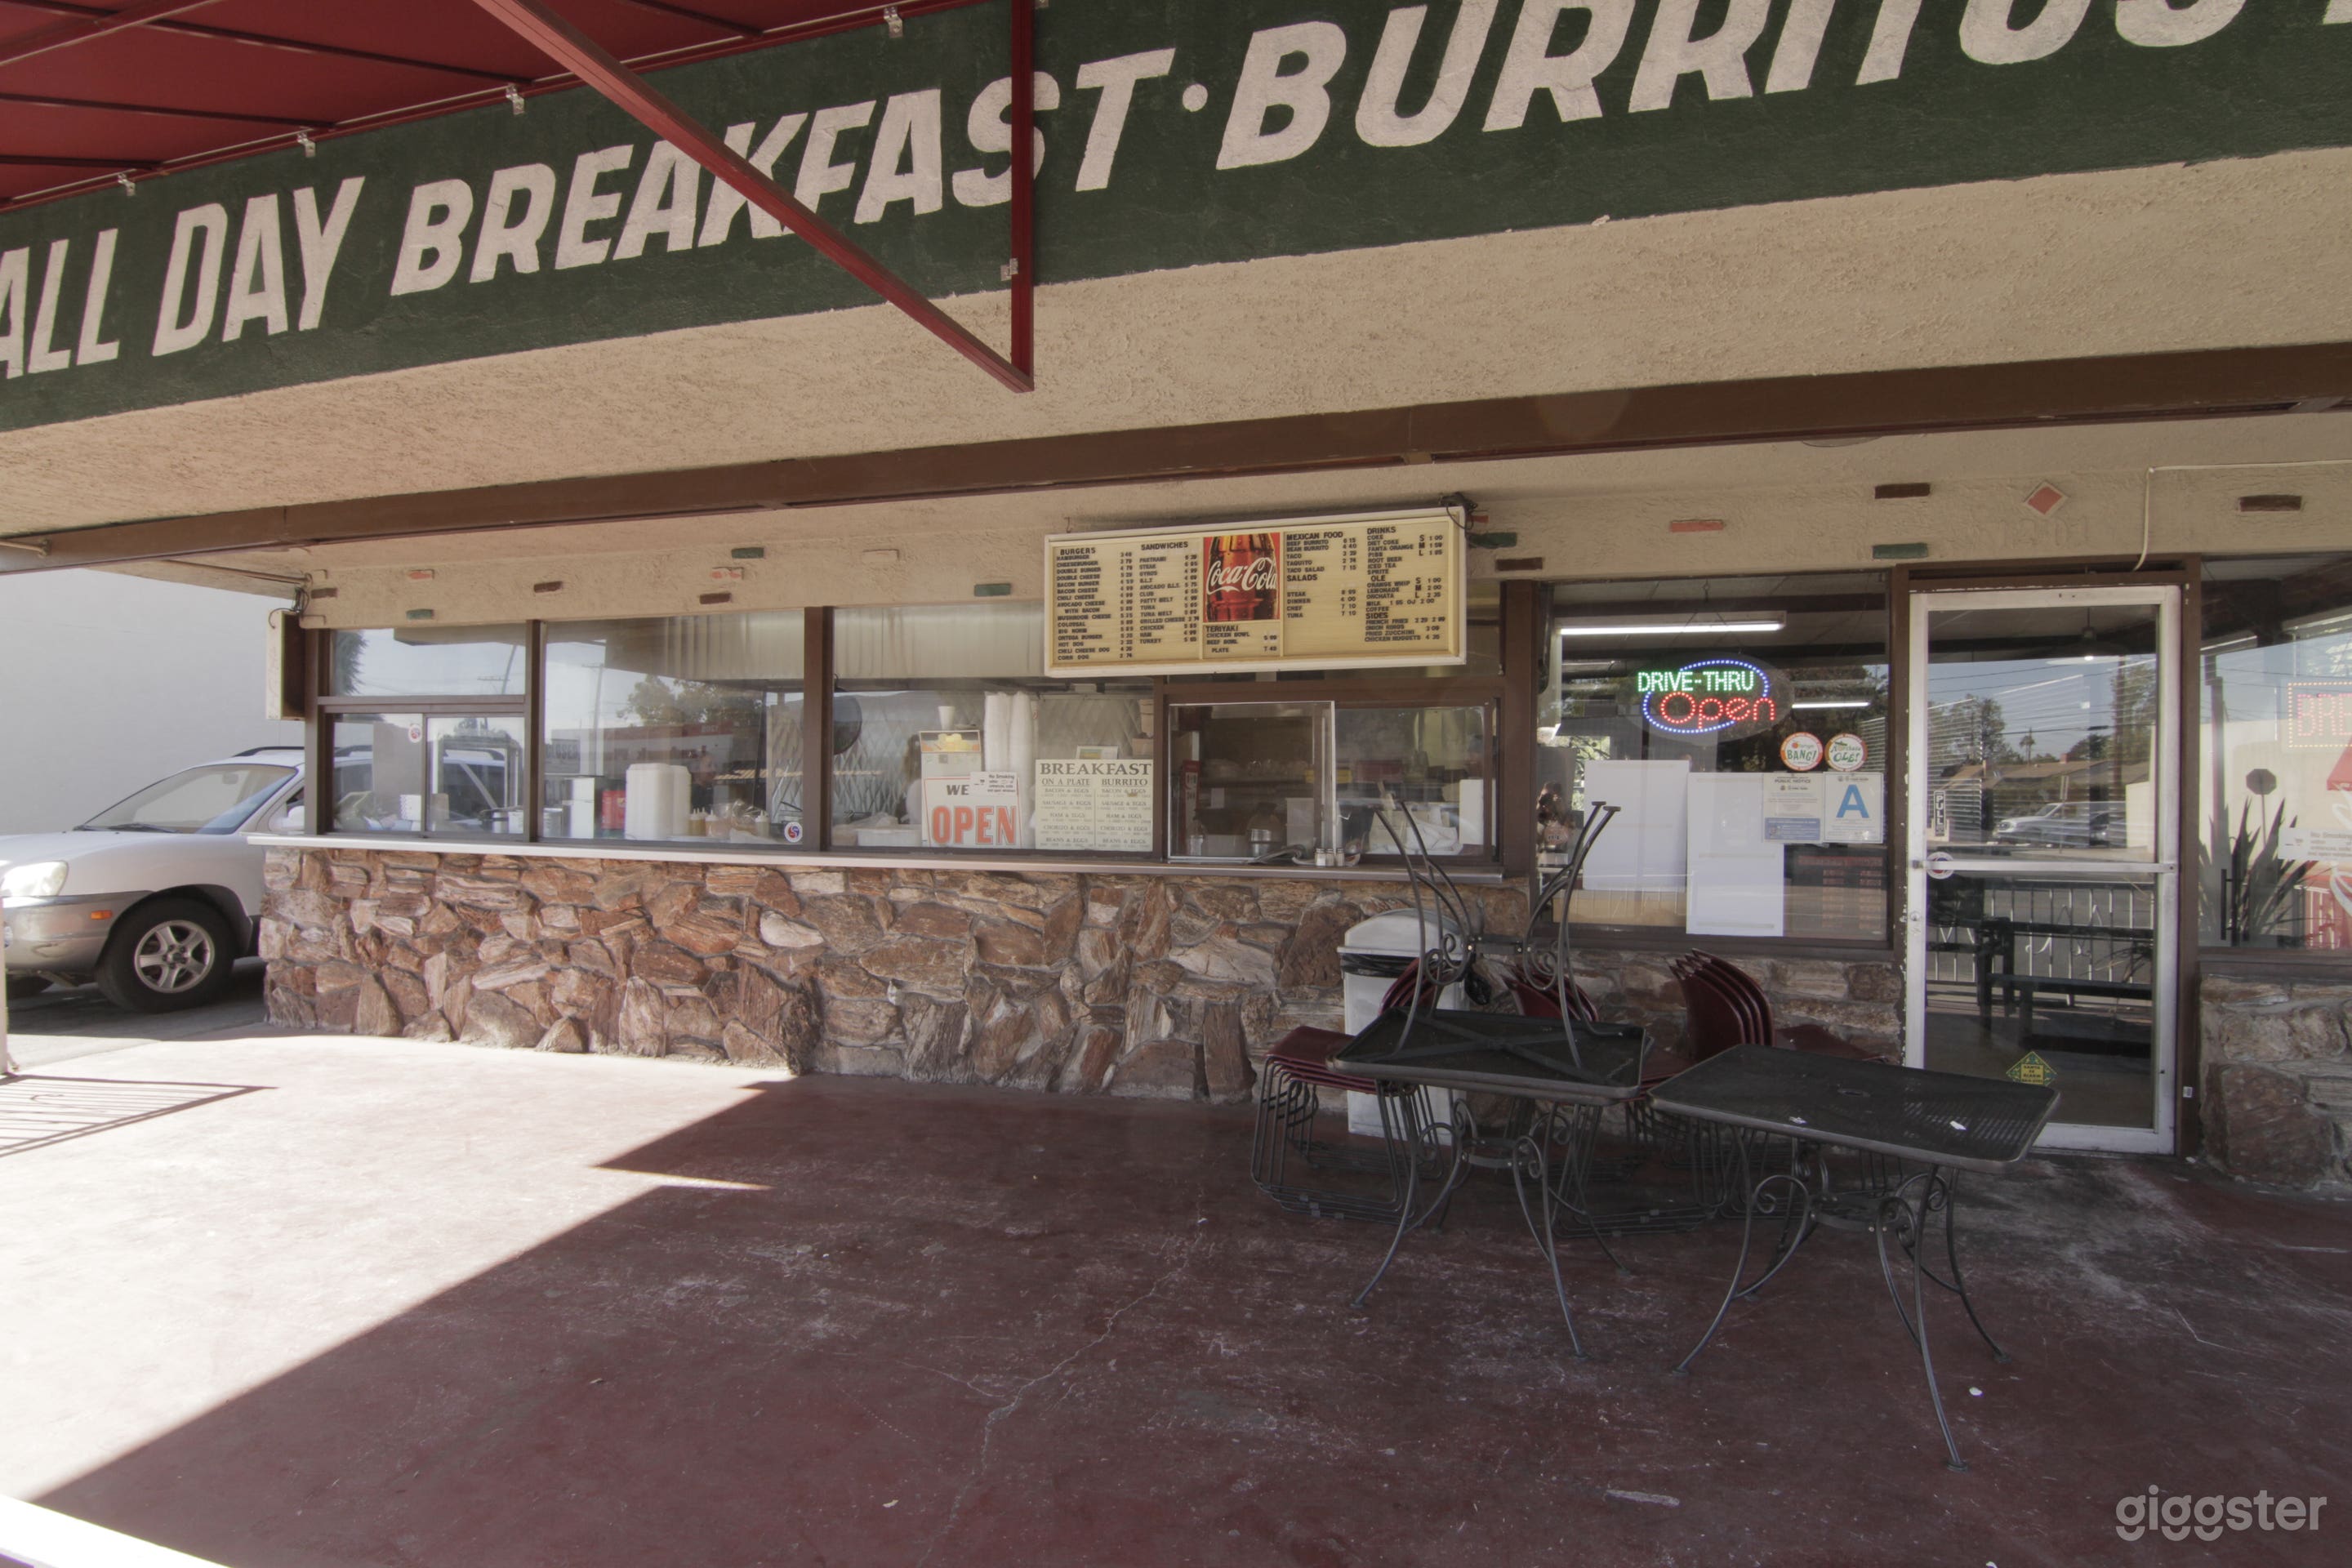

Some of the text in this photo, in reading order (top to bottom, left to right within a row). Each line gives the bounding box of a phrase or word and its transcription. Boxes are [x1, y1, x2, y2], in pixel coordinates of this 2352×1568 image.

[0, 228, 120, 379] ALL
[152, 176, 366, 356] DAY
[390, 48, 1174, 296] BREAKFAST
[1060, 547, 1095, 555] BURGERS
[1141, 541, 1188, 550] SANDWICHES
[1206, 558, 1276, 595] Coca-Cola
[1638, 671, 1754, 692] DRIVE-THRU
[1660, 691, 1775, 728] Open
[1787, 750, 1816, 760] BANG!
[1833, 752, 1860, 762] OLE!
[1040, 764, 1152, 775] BREAKFAST
[947, 785, 969, 795] WE
[1836, 785, 1869, 818] A
[932, 806, 1018, 844] OPEN
